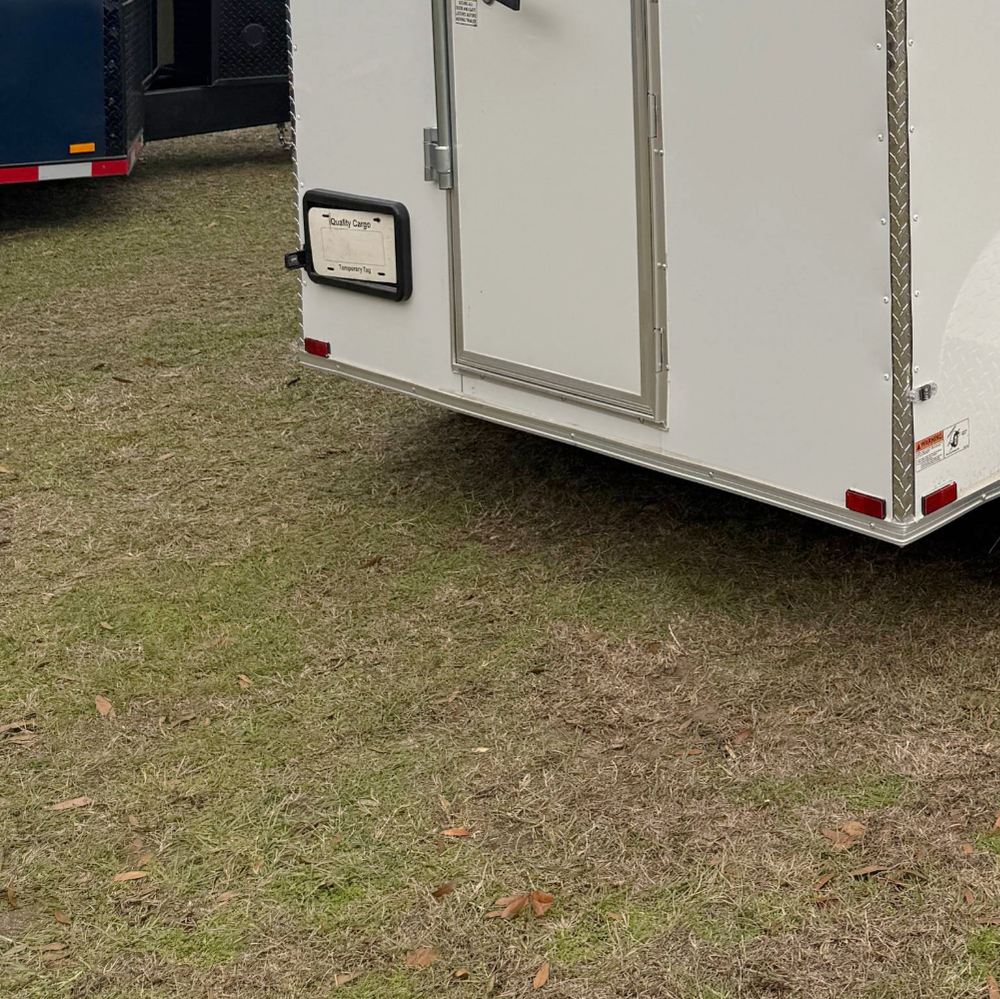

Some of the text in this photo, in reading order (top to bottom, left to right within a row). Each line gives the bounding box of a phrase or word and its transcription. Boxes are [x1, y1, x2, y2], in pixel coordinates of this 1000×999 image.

[330, 217, 371, 230] Quality Cargo
[338, 264, 372, 275] Temporary Tag
